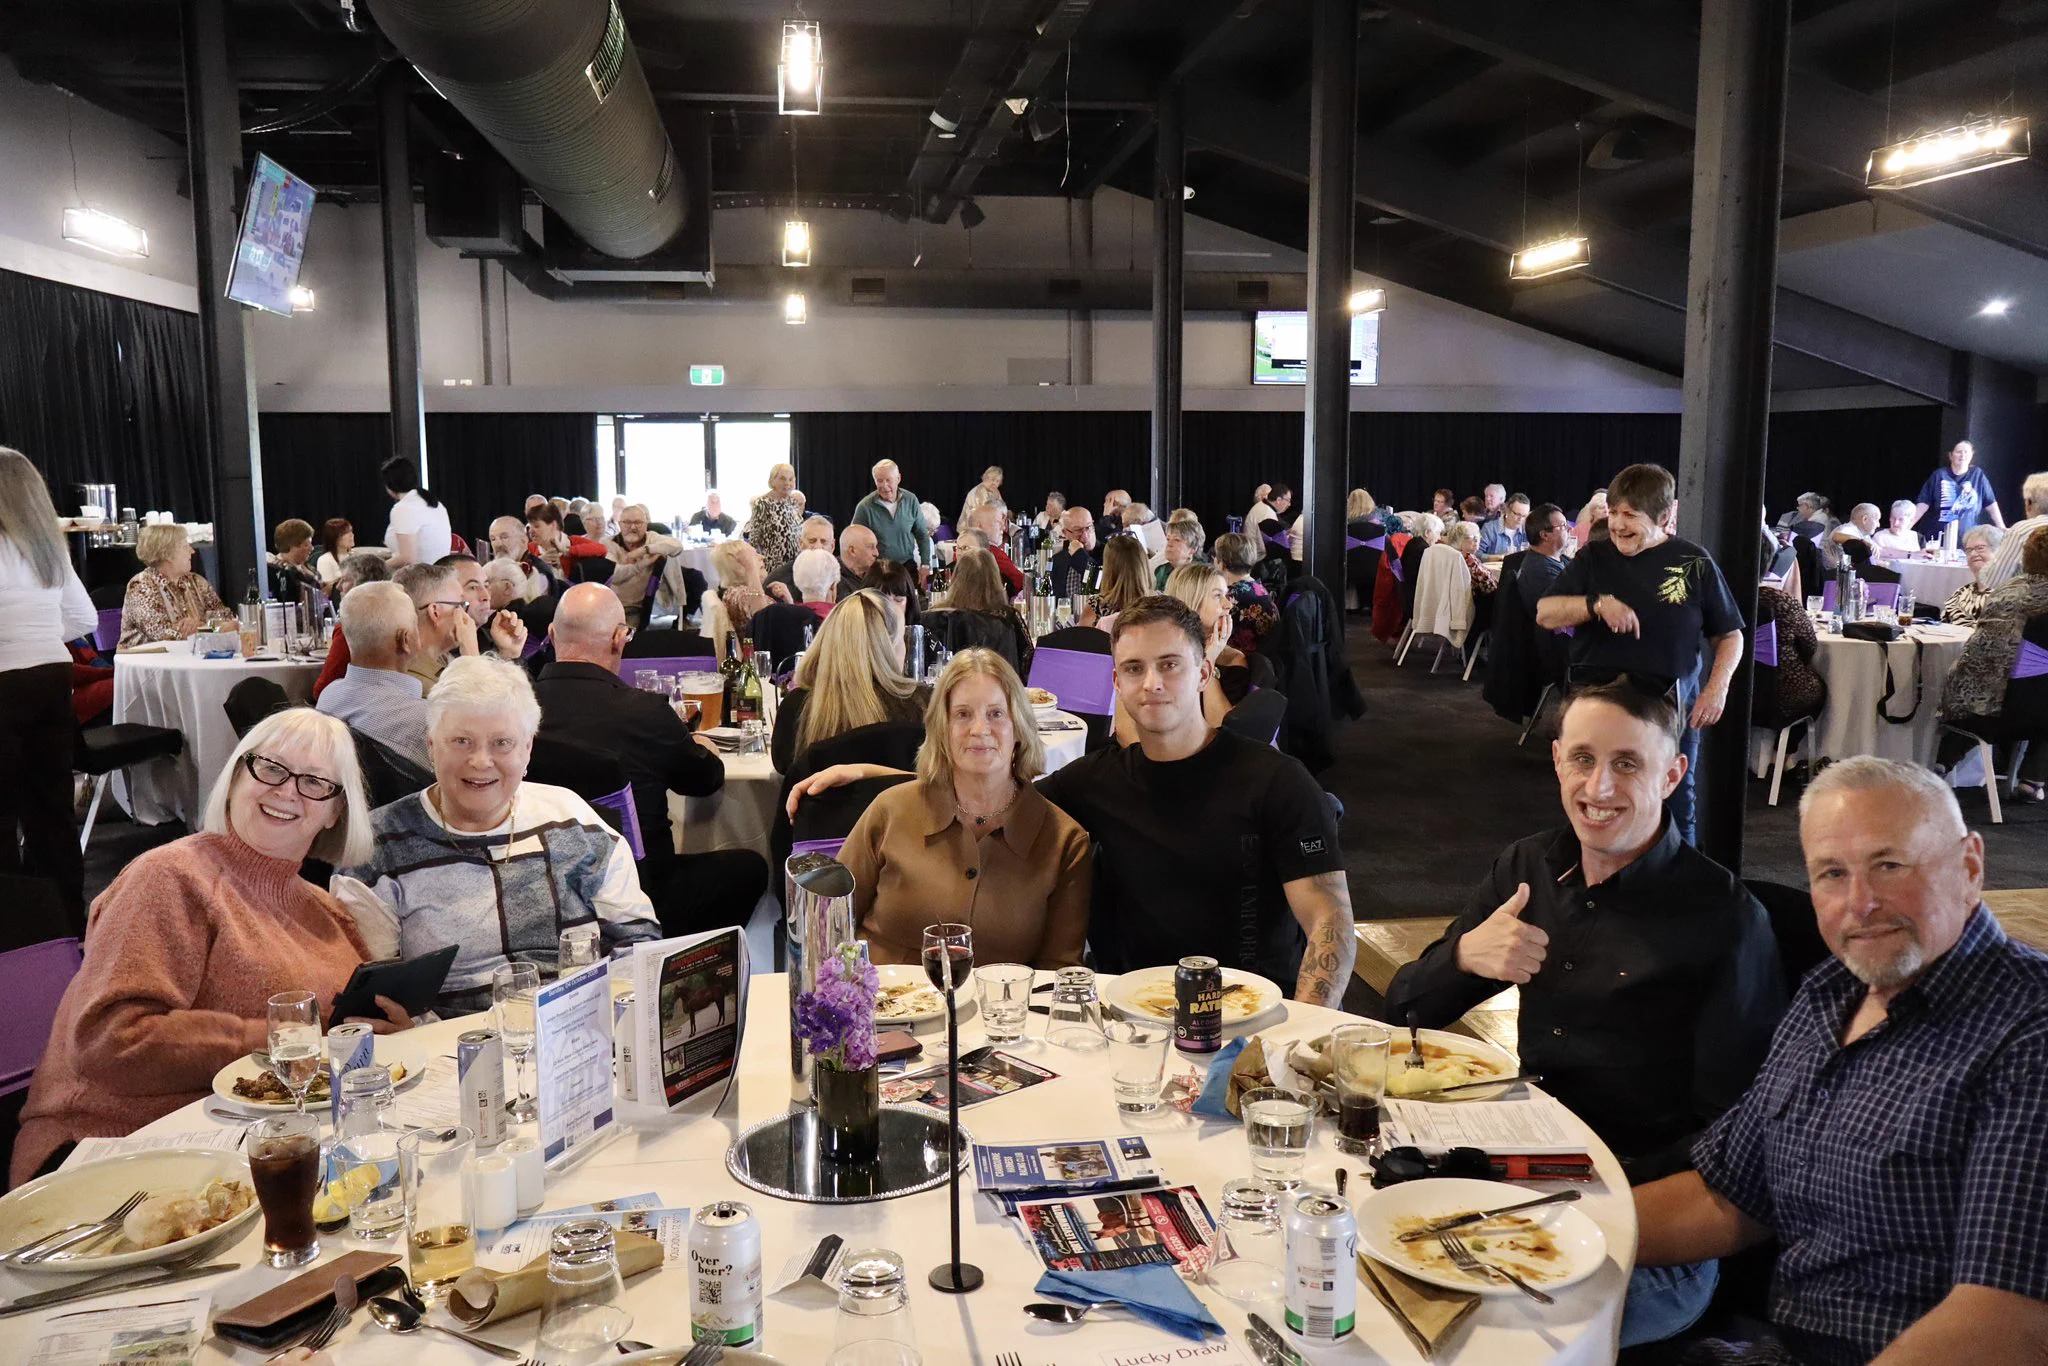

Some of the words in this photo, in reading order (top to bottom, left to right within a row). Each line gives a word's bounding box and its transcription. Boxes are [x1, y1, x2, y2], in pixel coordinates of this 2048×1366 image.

[1303, 839, 1322, 851] EA7
[1190, 1001, 1222, 1014] RATE
[691, 1250, 719, 1265] Over
[698, 1263, 733, 1276] beer?
[1114, 1351, 1171, 1366] Lucky
[1176, 1344, 1228, 1360] Draw
